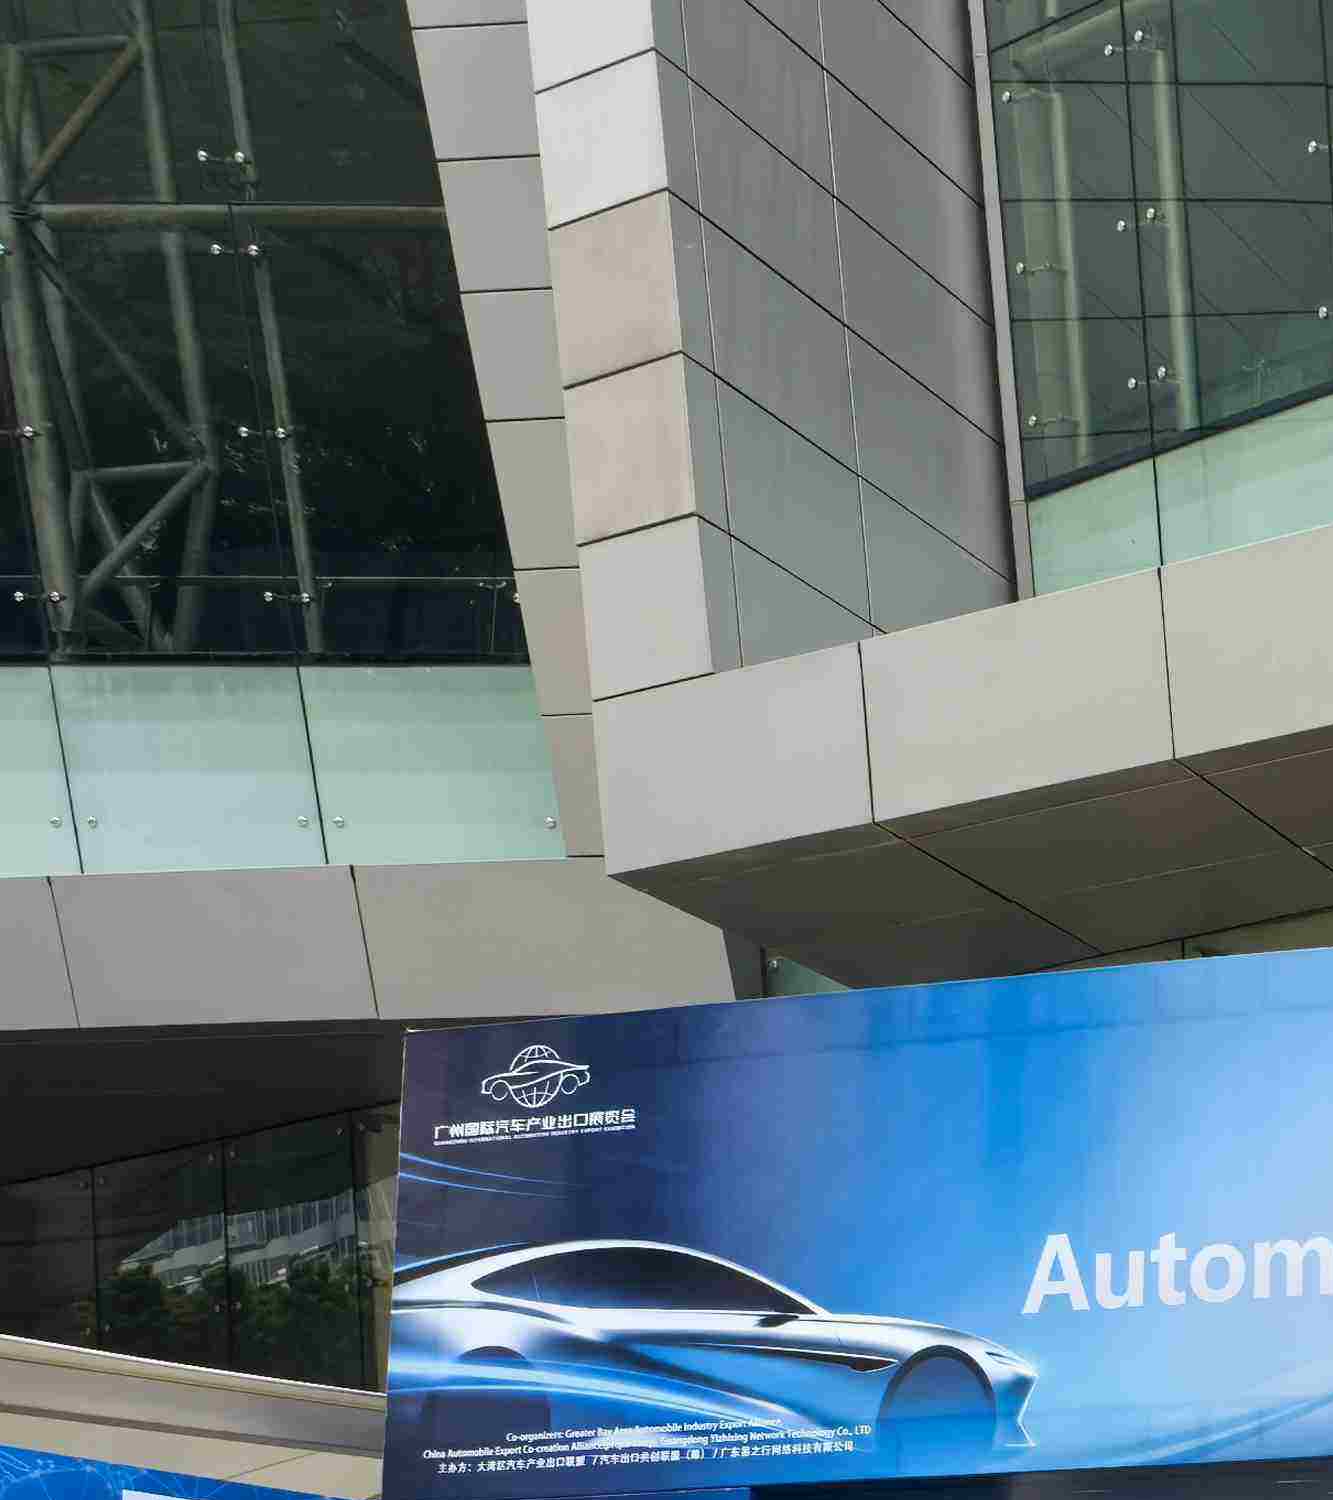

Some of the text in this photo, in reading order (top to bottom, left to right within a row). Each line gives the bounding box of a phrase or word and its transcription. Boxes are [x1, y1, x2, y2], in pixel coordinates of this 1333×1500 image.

[423, 1449, 446, 1460] China
[447, 1447, 495, 1458] Automobile
[496, 1445, 522, 1457] Export
